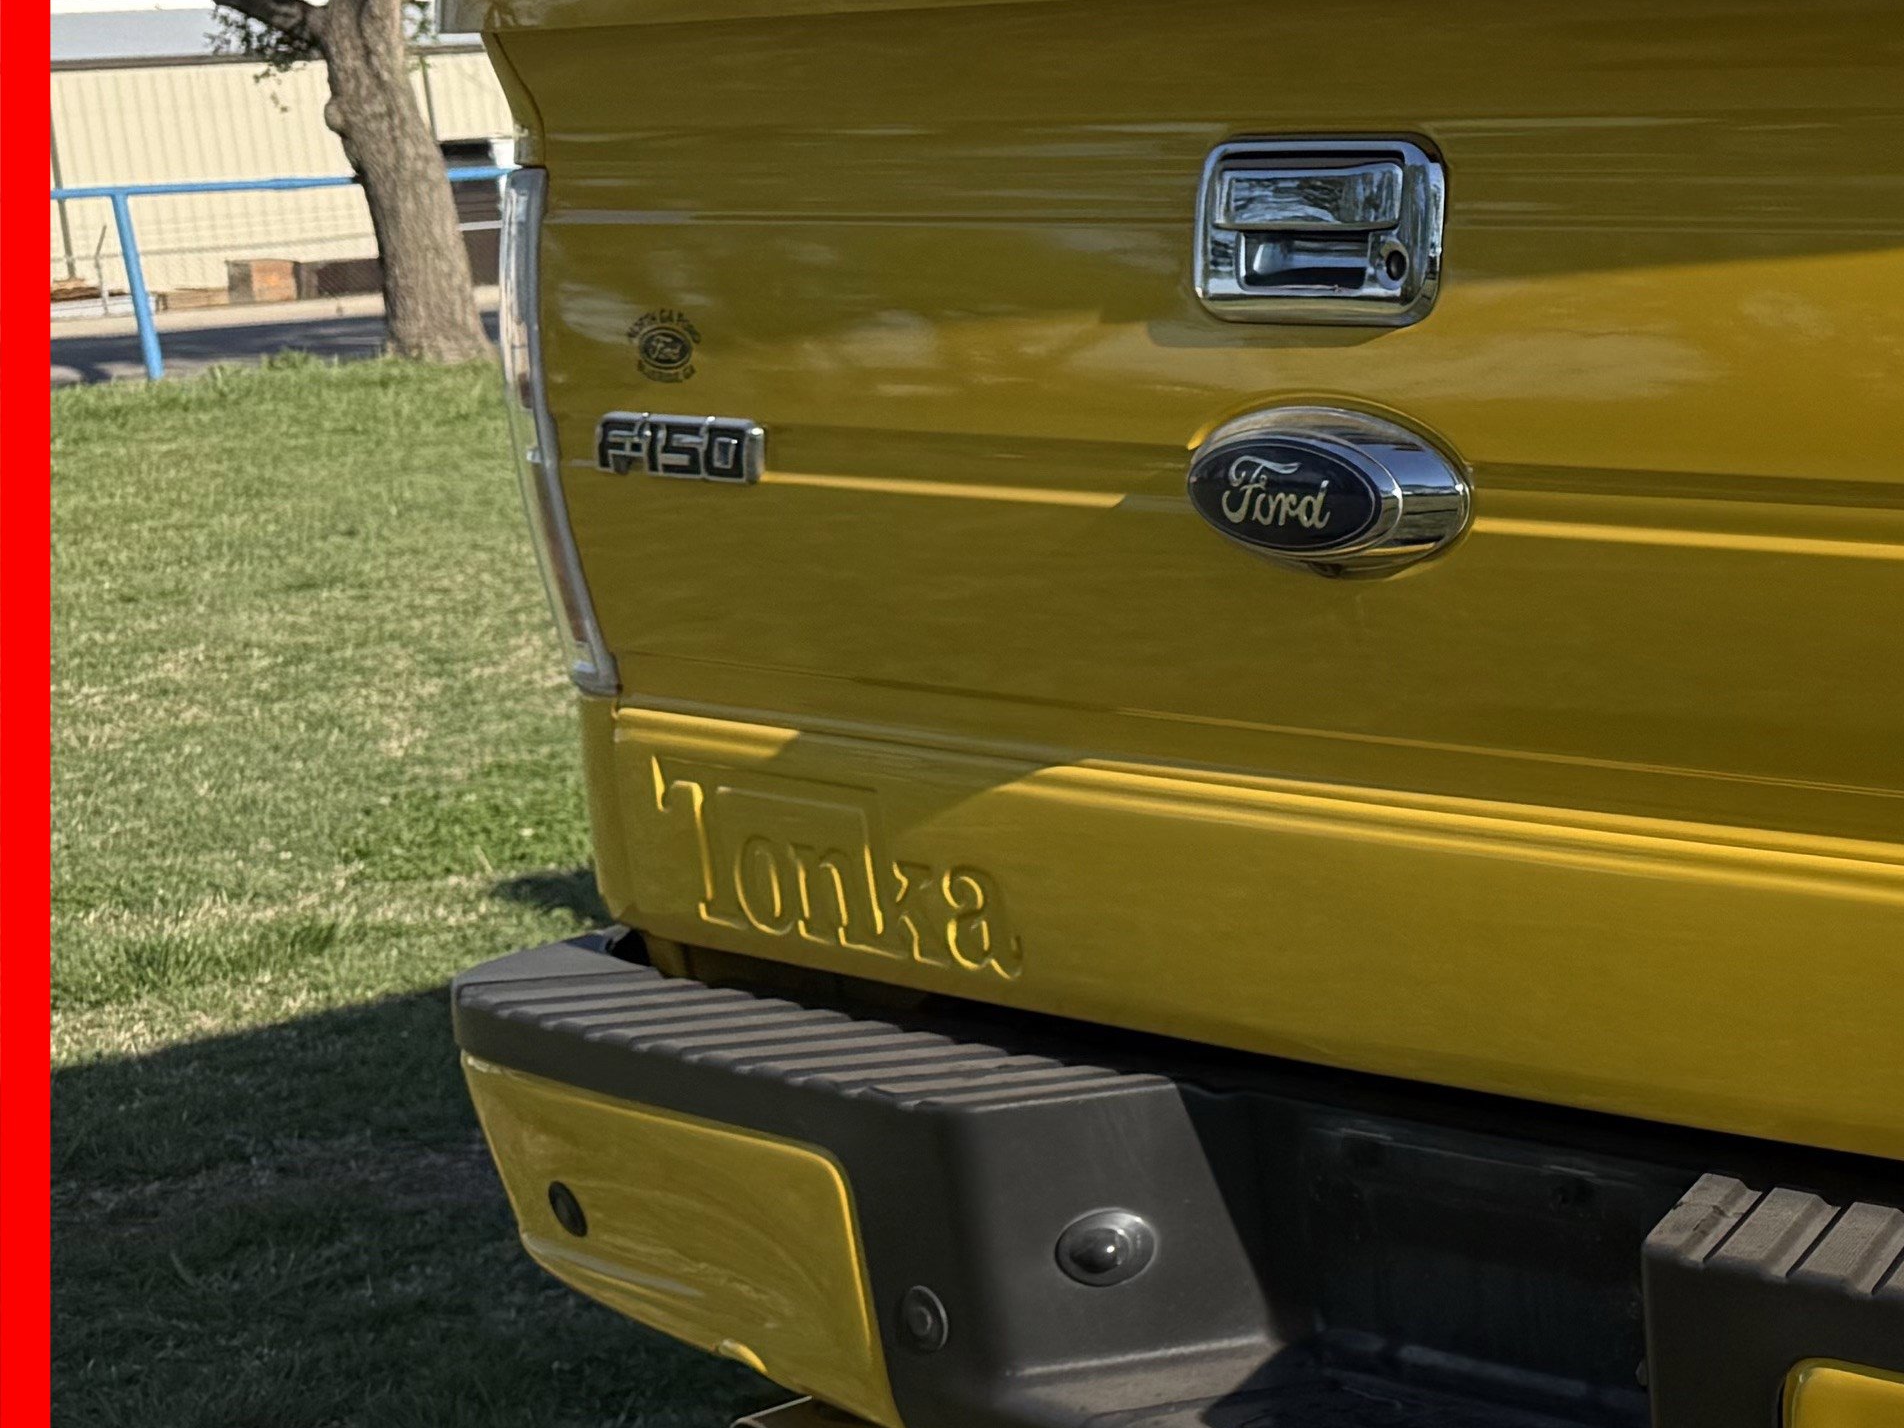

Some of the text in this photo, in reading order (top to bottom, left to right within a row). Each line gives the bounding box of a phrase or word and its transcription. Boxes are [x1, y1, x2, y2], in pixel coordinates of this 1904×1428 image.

[598, 420, 748, 480] F-150
[1221, 455, 1331, 529] Ford
[651, 756, 1022, 981] Tonka
